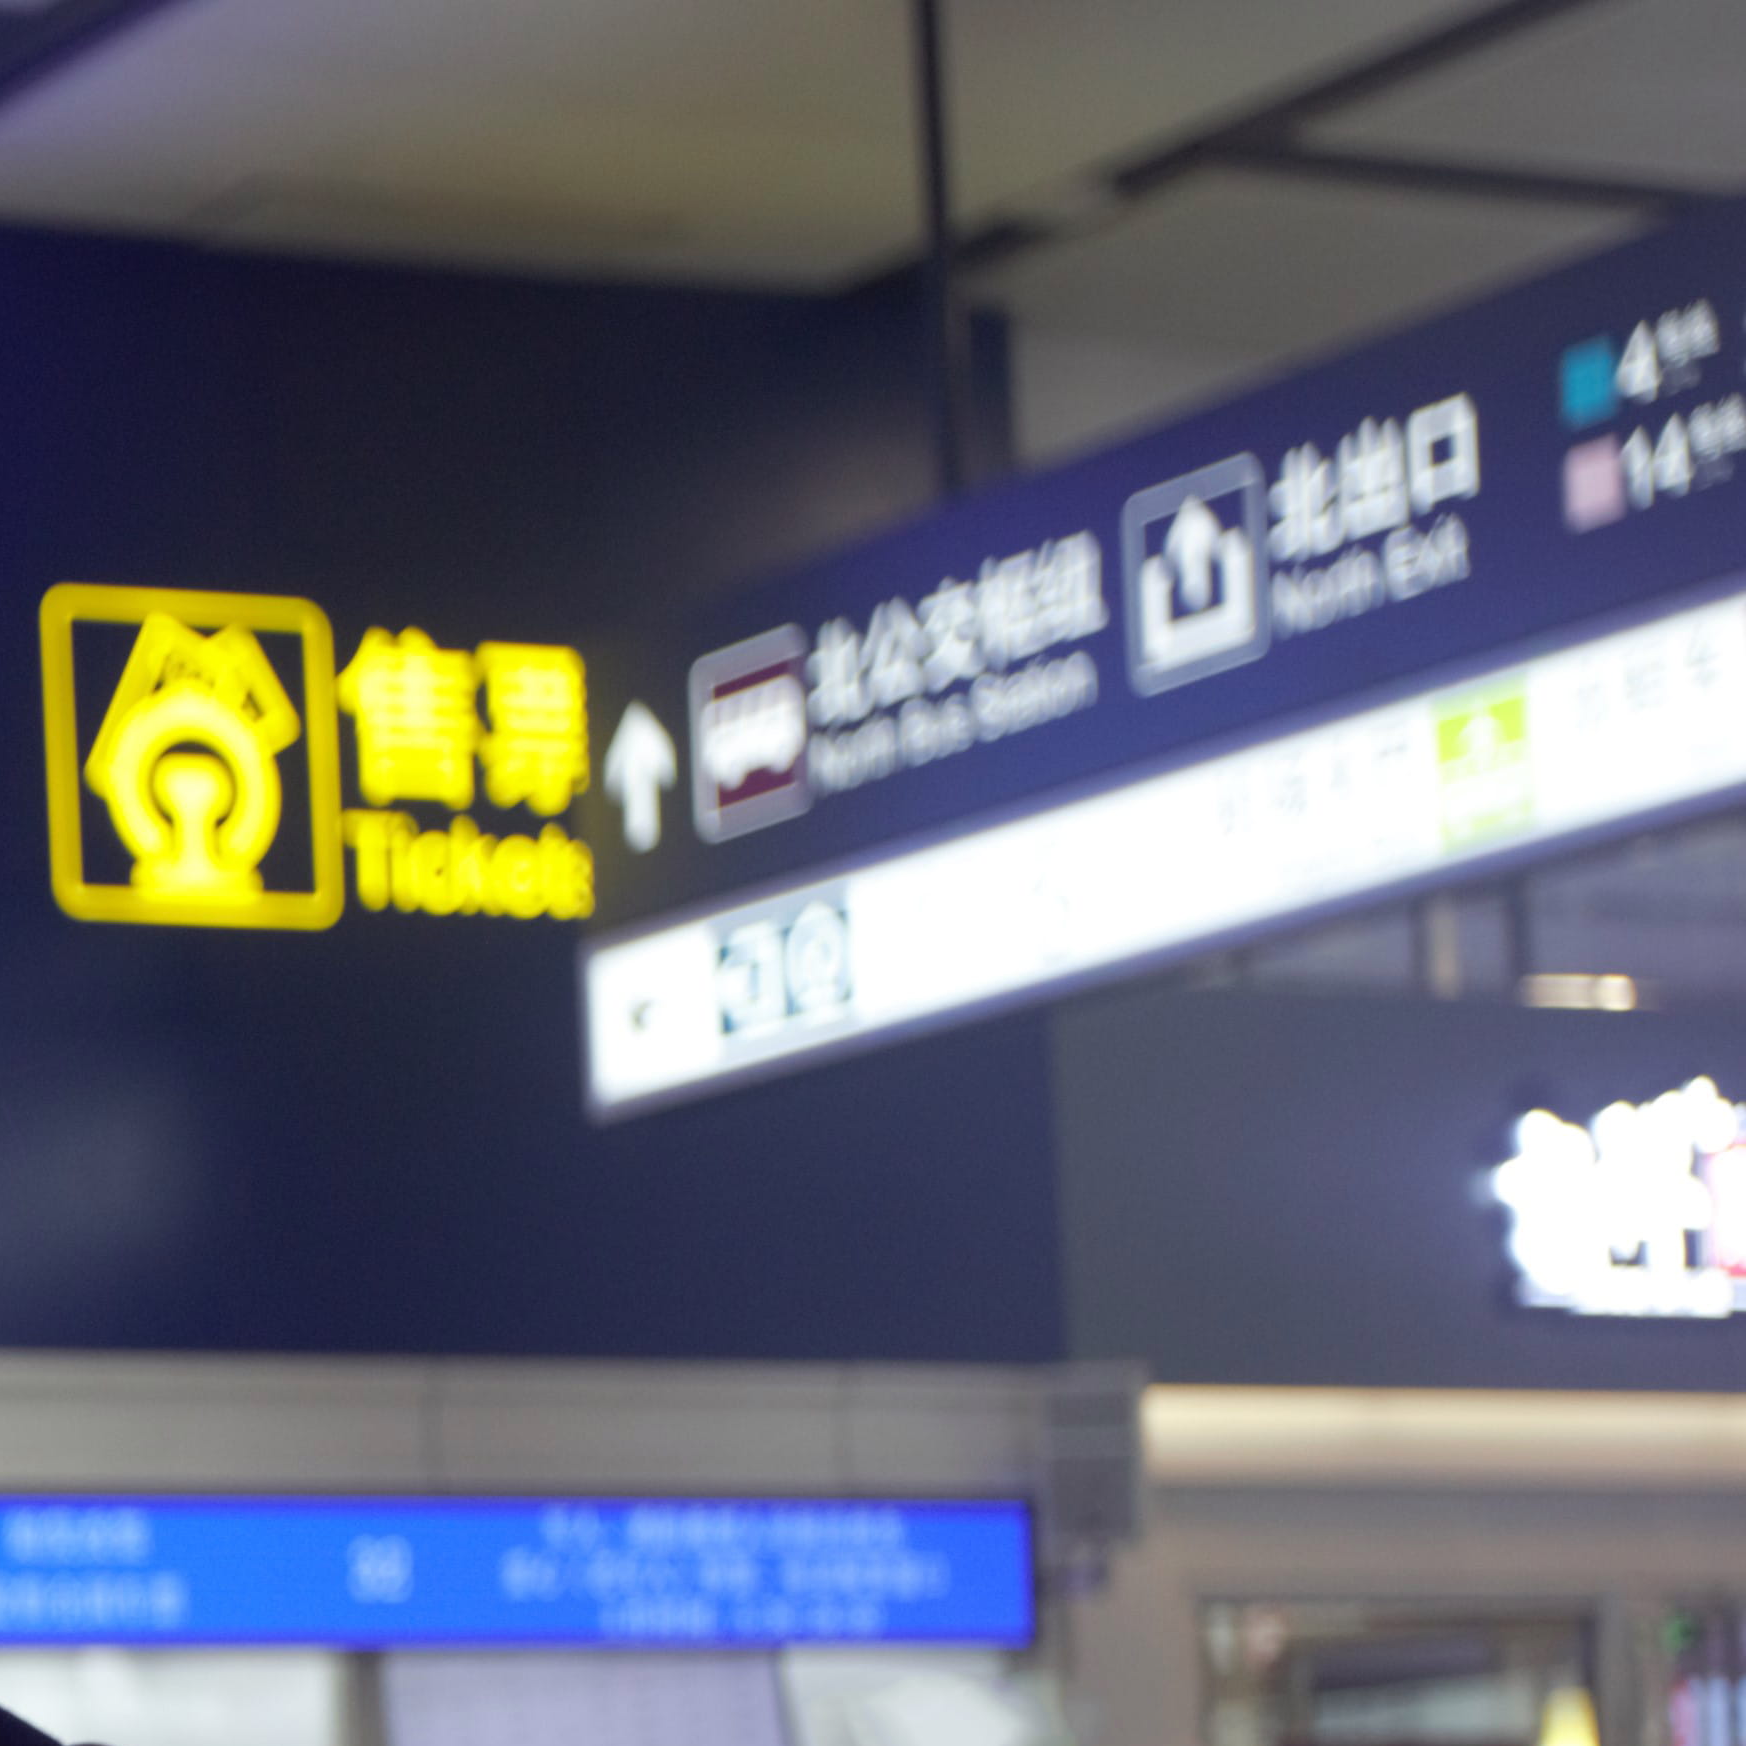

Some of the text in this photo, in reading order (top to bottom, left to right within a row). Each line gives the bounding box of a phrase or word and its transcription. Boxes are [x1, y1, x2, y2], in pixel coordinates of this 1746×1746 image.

[1268, 392, 1481, 564] 北出口
[806, 530, 1109, 728] 北公交枢纽
[1272, 512, 1472, 641] North Exit
[808, 650, 1100, 796] North Bus Station
[342, 807, 596, 921] Tickets
